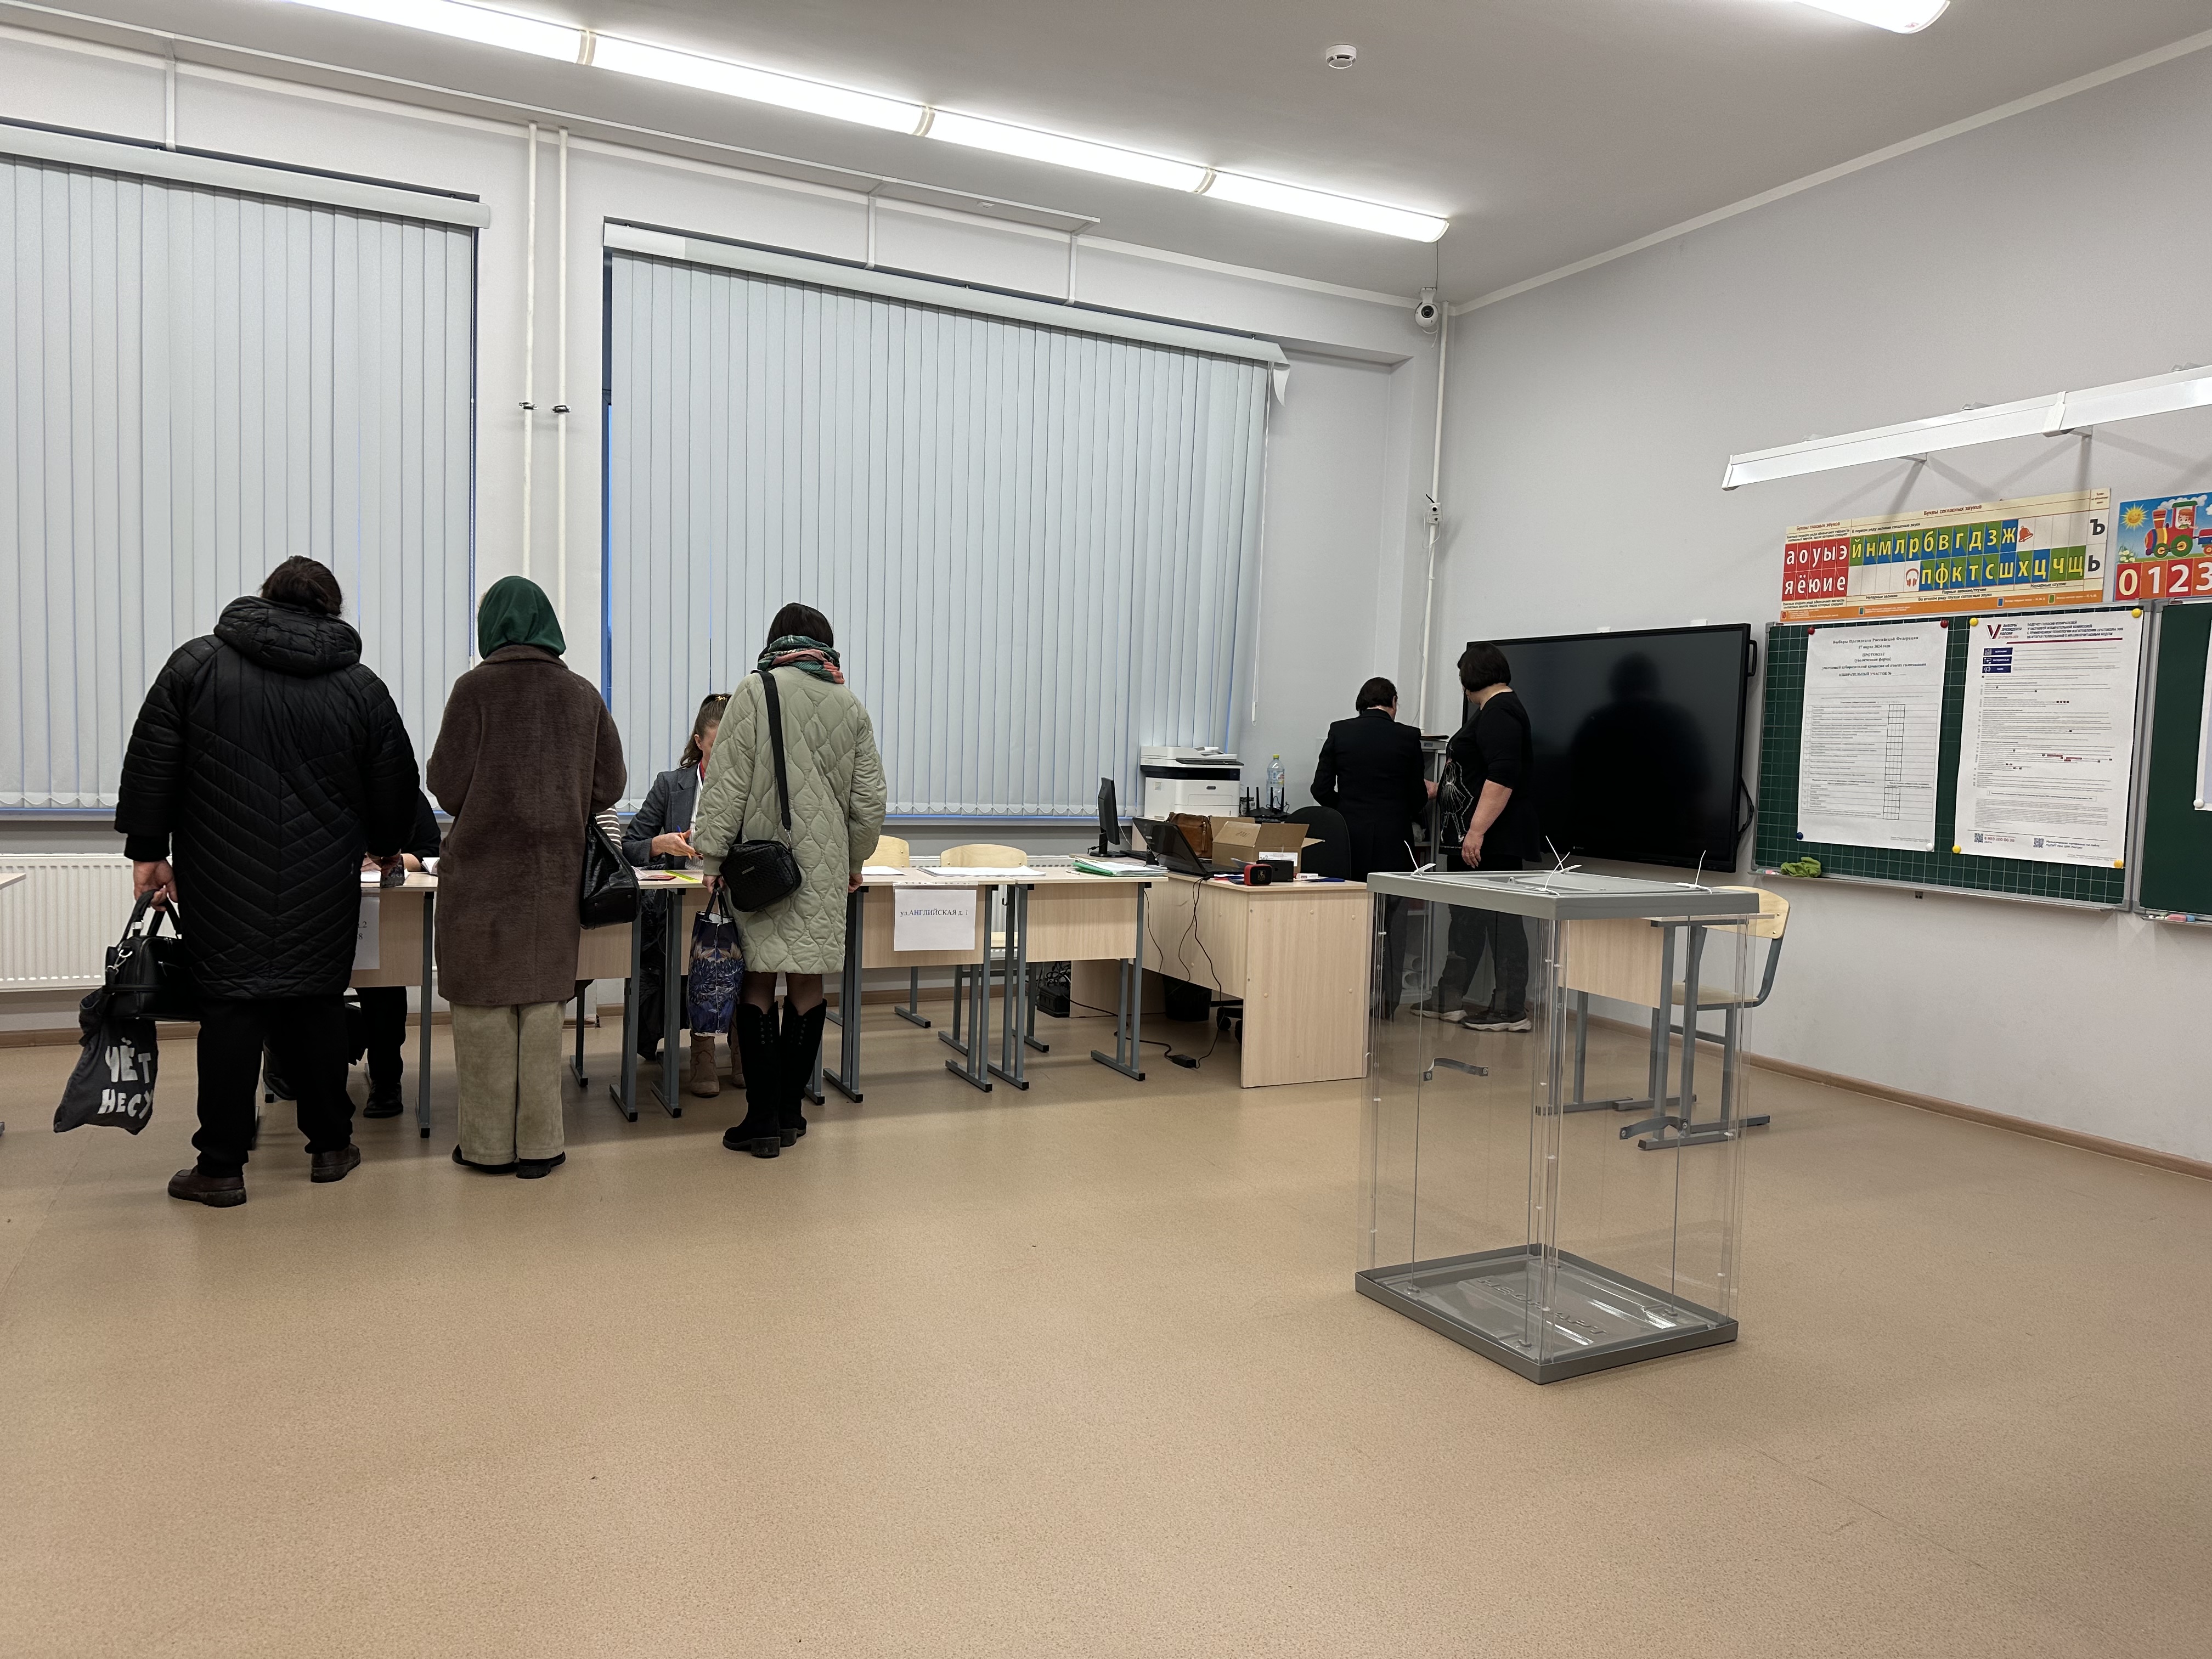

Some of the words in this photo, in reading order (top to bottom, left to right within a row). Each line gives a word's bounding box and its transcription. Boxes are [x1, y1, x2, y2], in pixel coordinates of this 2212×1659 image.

[1786, 551, 1795, 565] а
[1799, 549, 1808, 563] о
[1812, 548, 1821, 568] у
[1824, 546, 1836, 561] ы
[1839, 545, 1847, 560] э
[1852, 538, 1861, 558] й
[1866, 542, 1876, 556] н
[1878, 540, 1891, 555] м
[1895, 539, 1905, 554] л
[1909, 538, 1919, 558] р
[1923, 530, 1934, 552] б
[1939, 534, 1949, 550] в
[1956, 533, 1964, 548] г
[1969, 531, 1982, 551] д
[1987, 529, 1997, 545] з
[2002, 527, 2016, 544] ж
[1785, 580, 1793, 595] я
[1797, 574, 1806, 594] ё
[1808, 578, 1820, 593] ю
[1823, 577, 1832, 592] и
[1837, 576, 1846, 591] е
[1921, 569, 1932, 584] п
[1935, 562, 1949, 589] ф
[1952, 566, 1962, 582] к
[1968, 565, 1979, 580] т
[1985, 563, 1994, 579] с
[1999, 562, 2013, 578] ш
[2018, 561, 2029, 577] х
[2034, 560, 2046, 579] ц
[2053, 557, 2064, 574] ч
[2068, 556, 2083, 577] щ
[2119, 569, 2138, 596] 0
[2148, 566, 2160, 594] 1
[2169, 564, 2189, 592] 2
[2196, 562, 2212, 591] 3
[97, 1088, 154, 1120] НЕСУ
